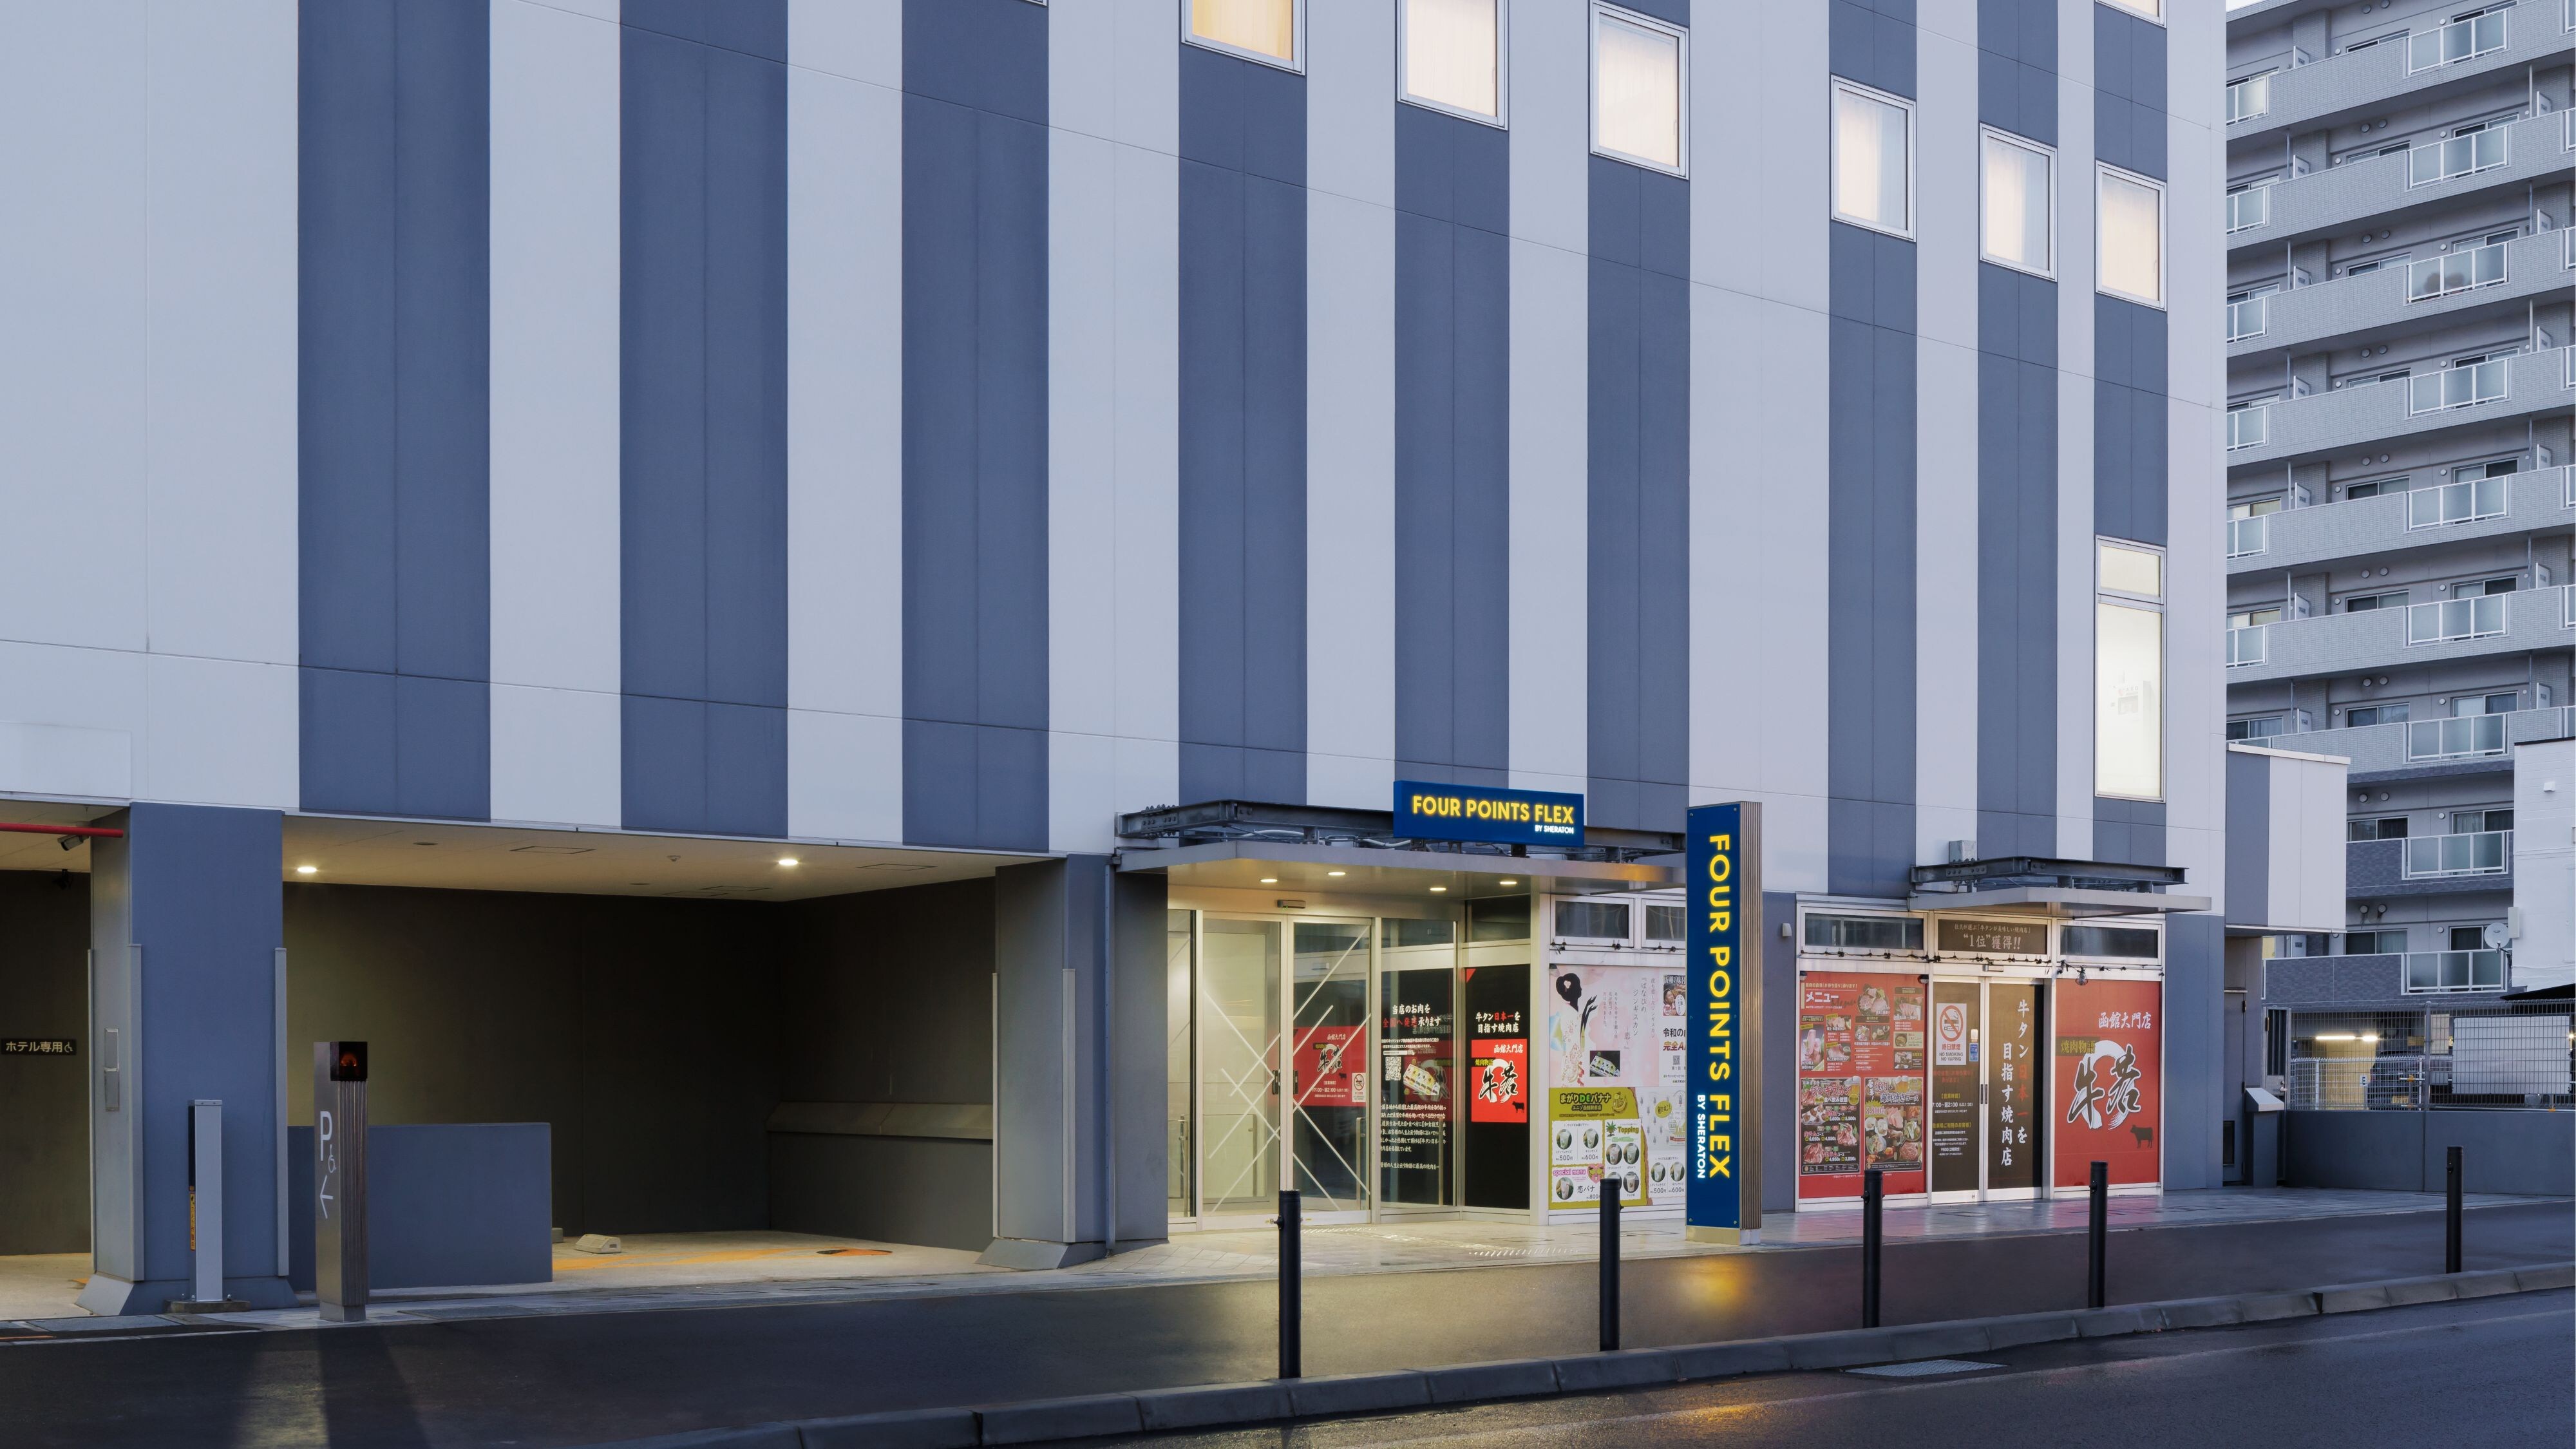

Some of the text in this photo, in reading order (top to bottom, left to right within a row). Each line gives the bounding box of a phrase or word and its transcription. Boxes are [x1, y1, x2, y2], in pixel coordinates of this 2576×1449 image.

[1413, 795, 1574, 824] FOUR POINTS FLEX
[1544, 825, 1574, 834] SHERATON
[1806, 991, 1839, 1003] メニュー
[1392, 1004, 1430, 1014] 当店のお肉を
[1709, 834, 1730, 1179] FOUR POINTS FLEX
[1475, 1011, 1520, 1022] 牛タン日本一を
[2098, 1012, 2152, 1029] 函館大門店
[1477, 1023, 1519, 1033] 目指す焼肉店
[1663, 1028, 1685, 1037] 令和の
[6, 1041, 62, 1052] ホテル専用
[1493, 1044, 1523, 1054] 函館大門店
[2061, 1039, 2096, 1054] 焼肉物語
[2017, 999, 2030, 1144] 牛タン日本一を
[1810, 1086, 1852, 1095] ジンギスカン
[1560, 1092, 1611, 1104] まがりDEバナナ
[2001, 1042, 2014, 1166] 目指す焼肉店
[320, 1111, 332, 1161] P
[1697, 1094, 1706, 1179] BY SHERATON
[1553, 1168, 1571, 1177] special
[1577, 1185, 1595, 1193] 恋バナ
